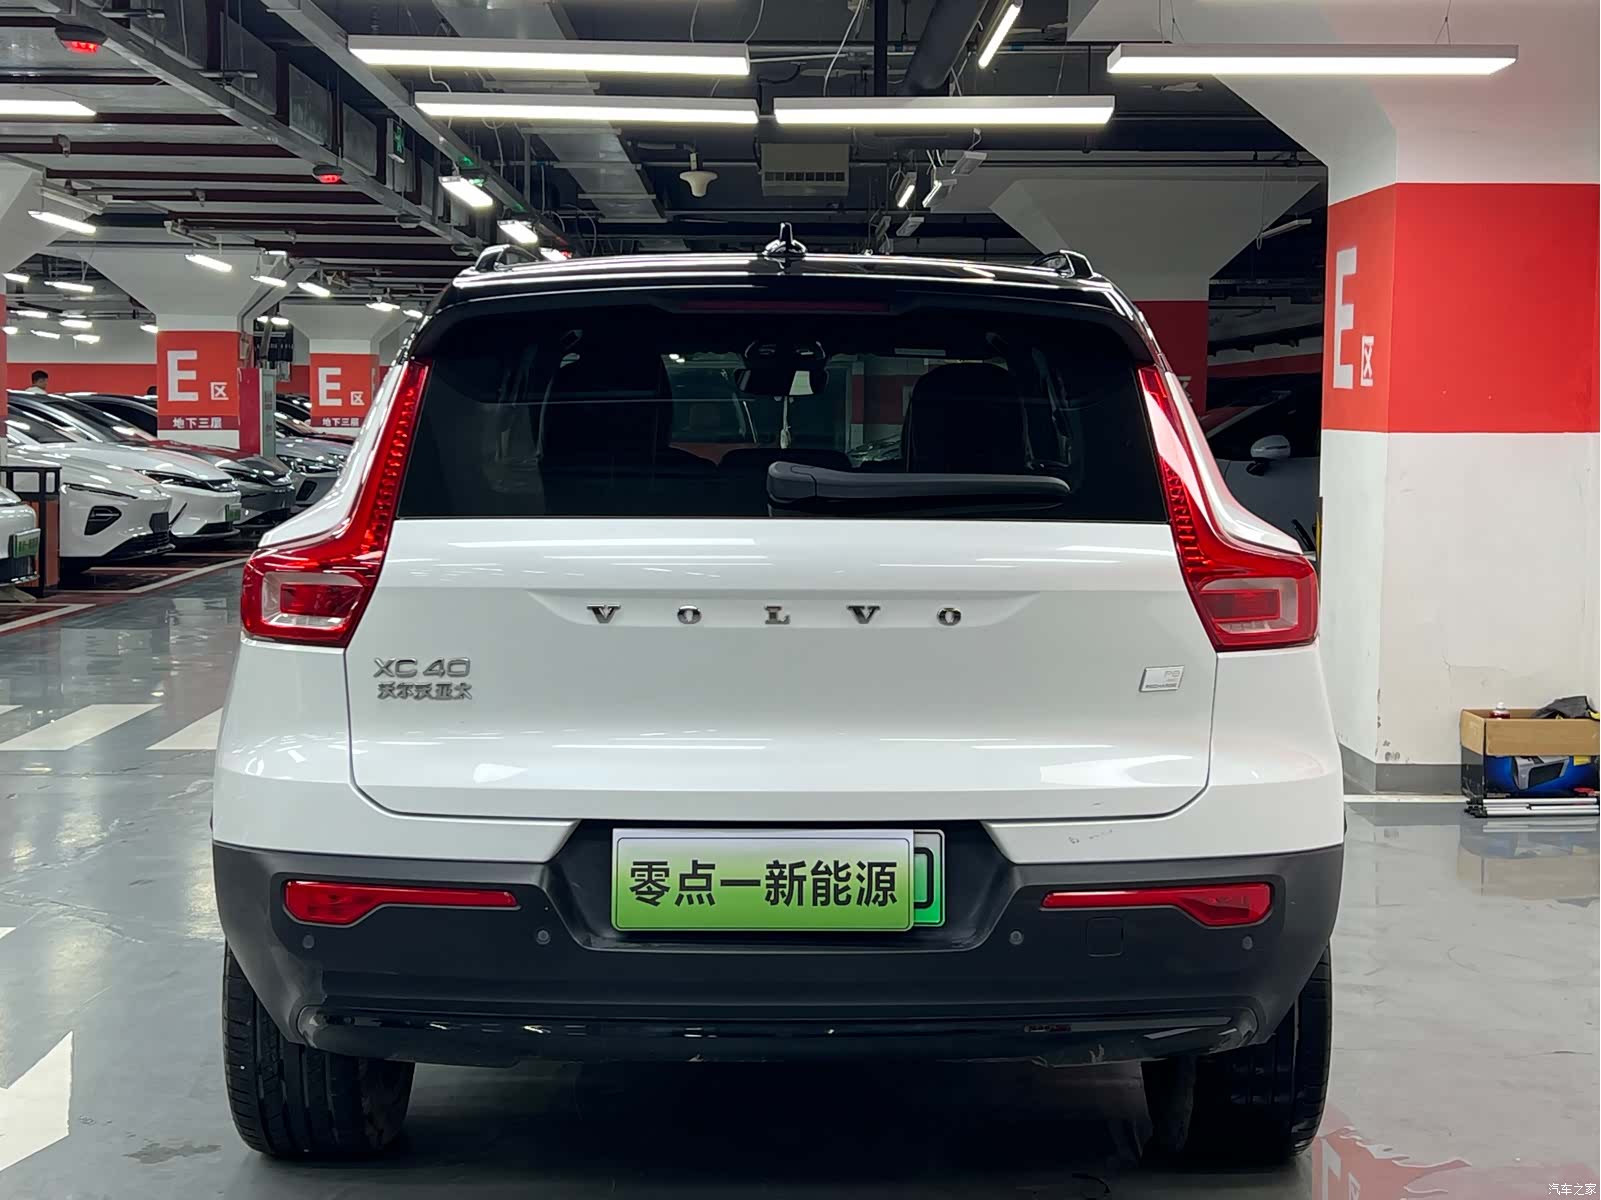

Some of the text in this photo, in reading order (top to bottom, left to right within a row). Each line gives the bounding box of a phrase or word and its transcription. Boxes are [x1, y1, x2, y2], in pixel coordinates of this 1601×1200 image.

[172, 416, 223, 429] 地下三层
[586, 604, 962, 626] VOLVO
[629, 859, 898, 908] 零点一新能源
